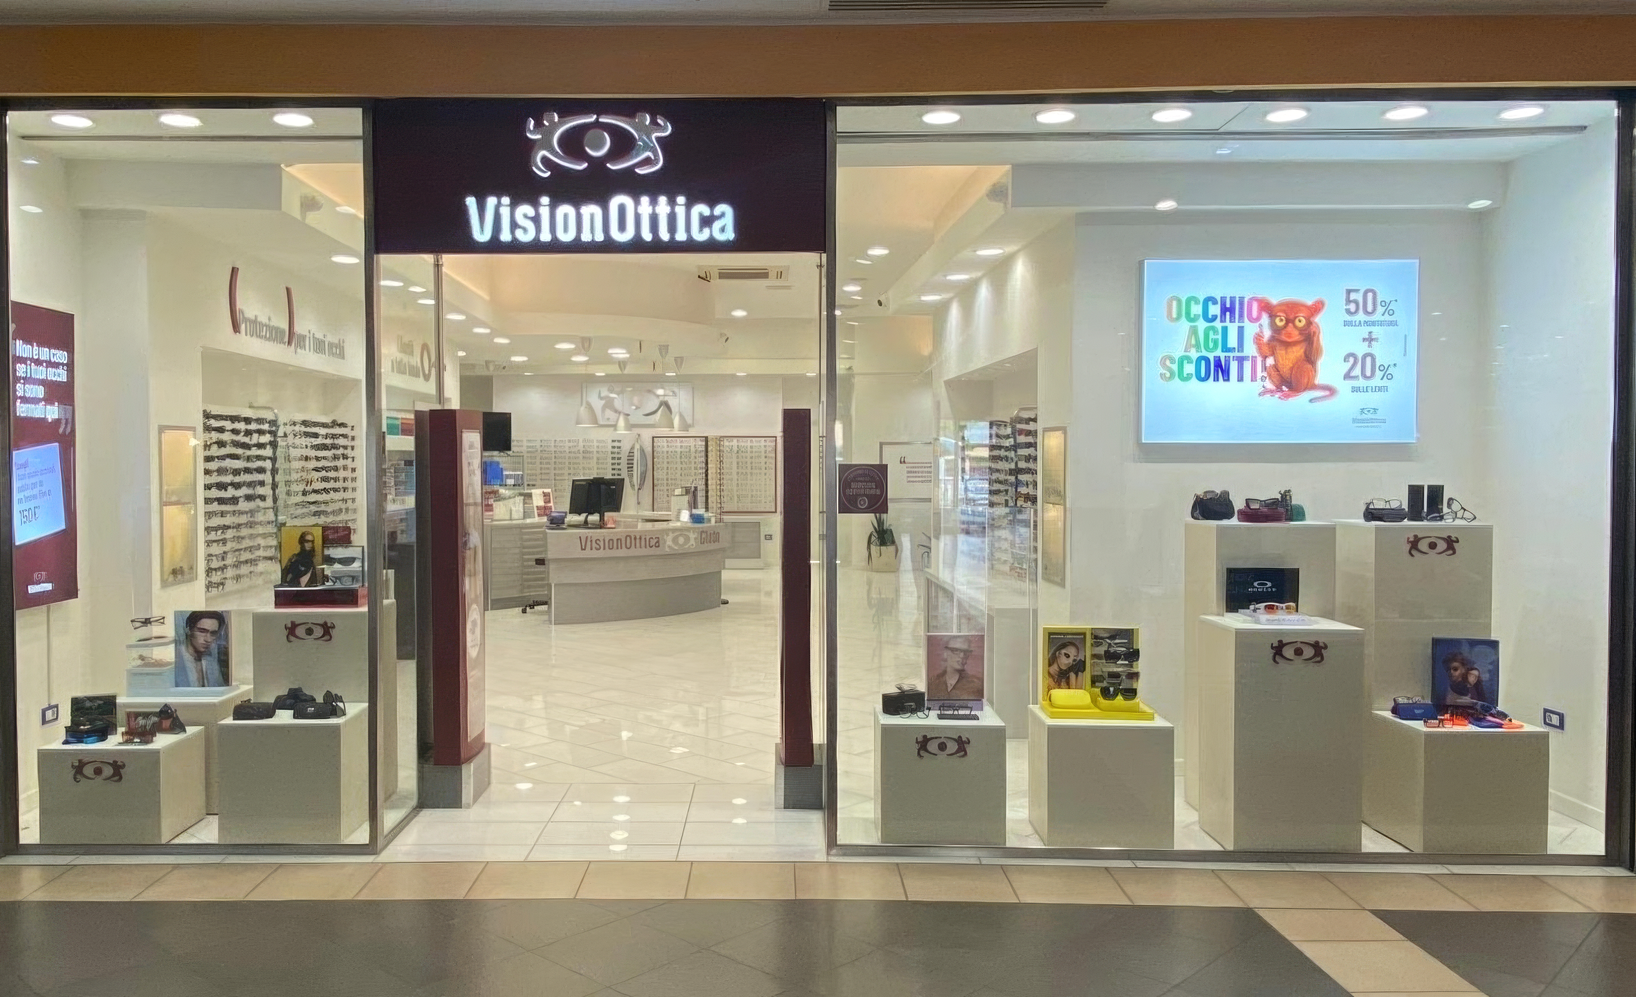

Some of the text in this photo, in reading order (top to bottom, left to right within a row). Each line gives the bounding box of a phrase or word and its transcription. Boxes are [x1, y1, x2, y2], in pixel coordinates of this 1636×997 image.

[465, 195, 735, 243] VisionOttica
[1166, 295, 1263, 323] OCCHIO
[1183, 325, 1245, 353] AGLI
[40, 346, 50, 361] un
[579, 534, 660, 551] VisionOttica
